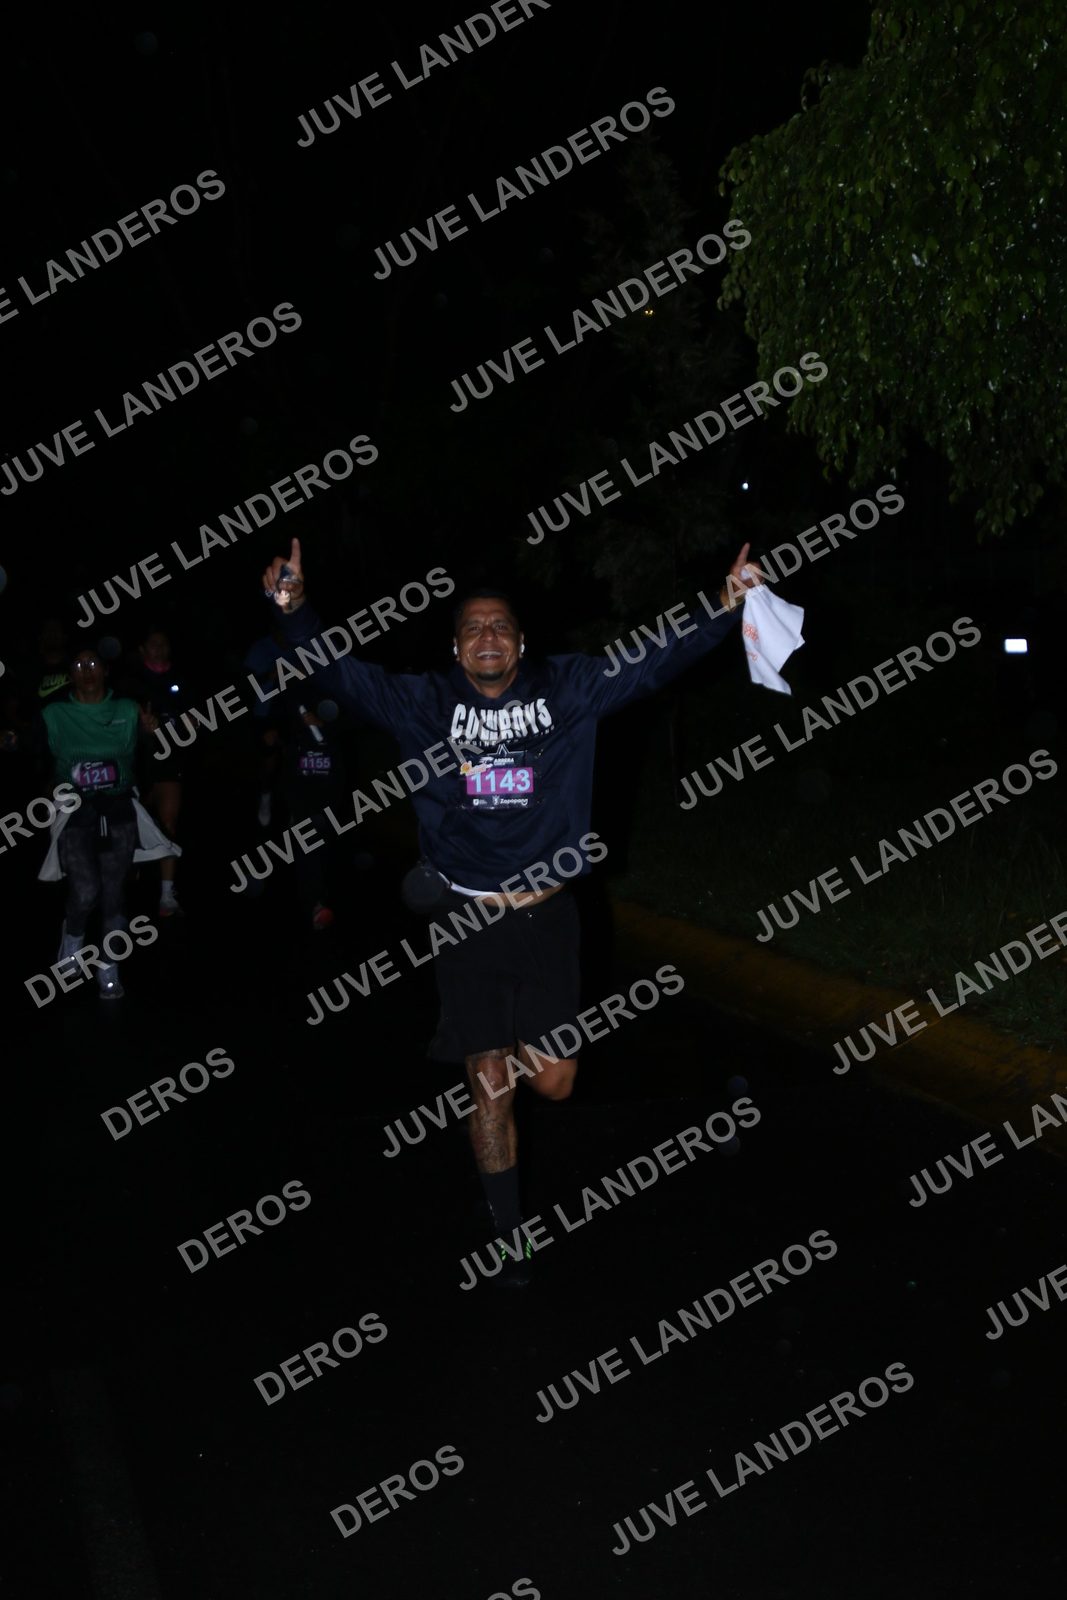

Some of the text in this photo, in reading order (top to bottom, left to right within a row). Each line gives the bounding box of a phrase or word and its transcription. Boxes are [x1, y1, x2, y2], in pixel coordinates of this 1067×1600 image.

[302, 757, 331, 769] 1155
[83, 767, 109, 784] 121
[471, 769, 531, 793] 1143
